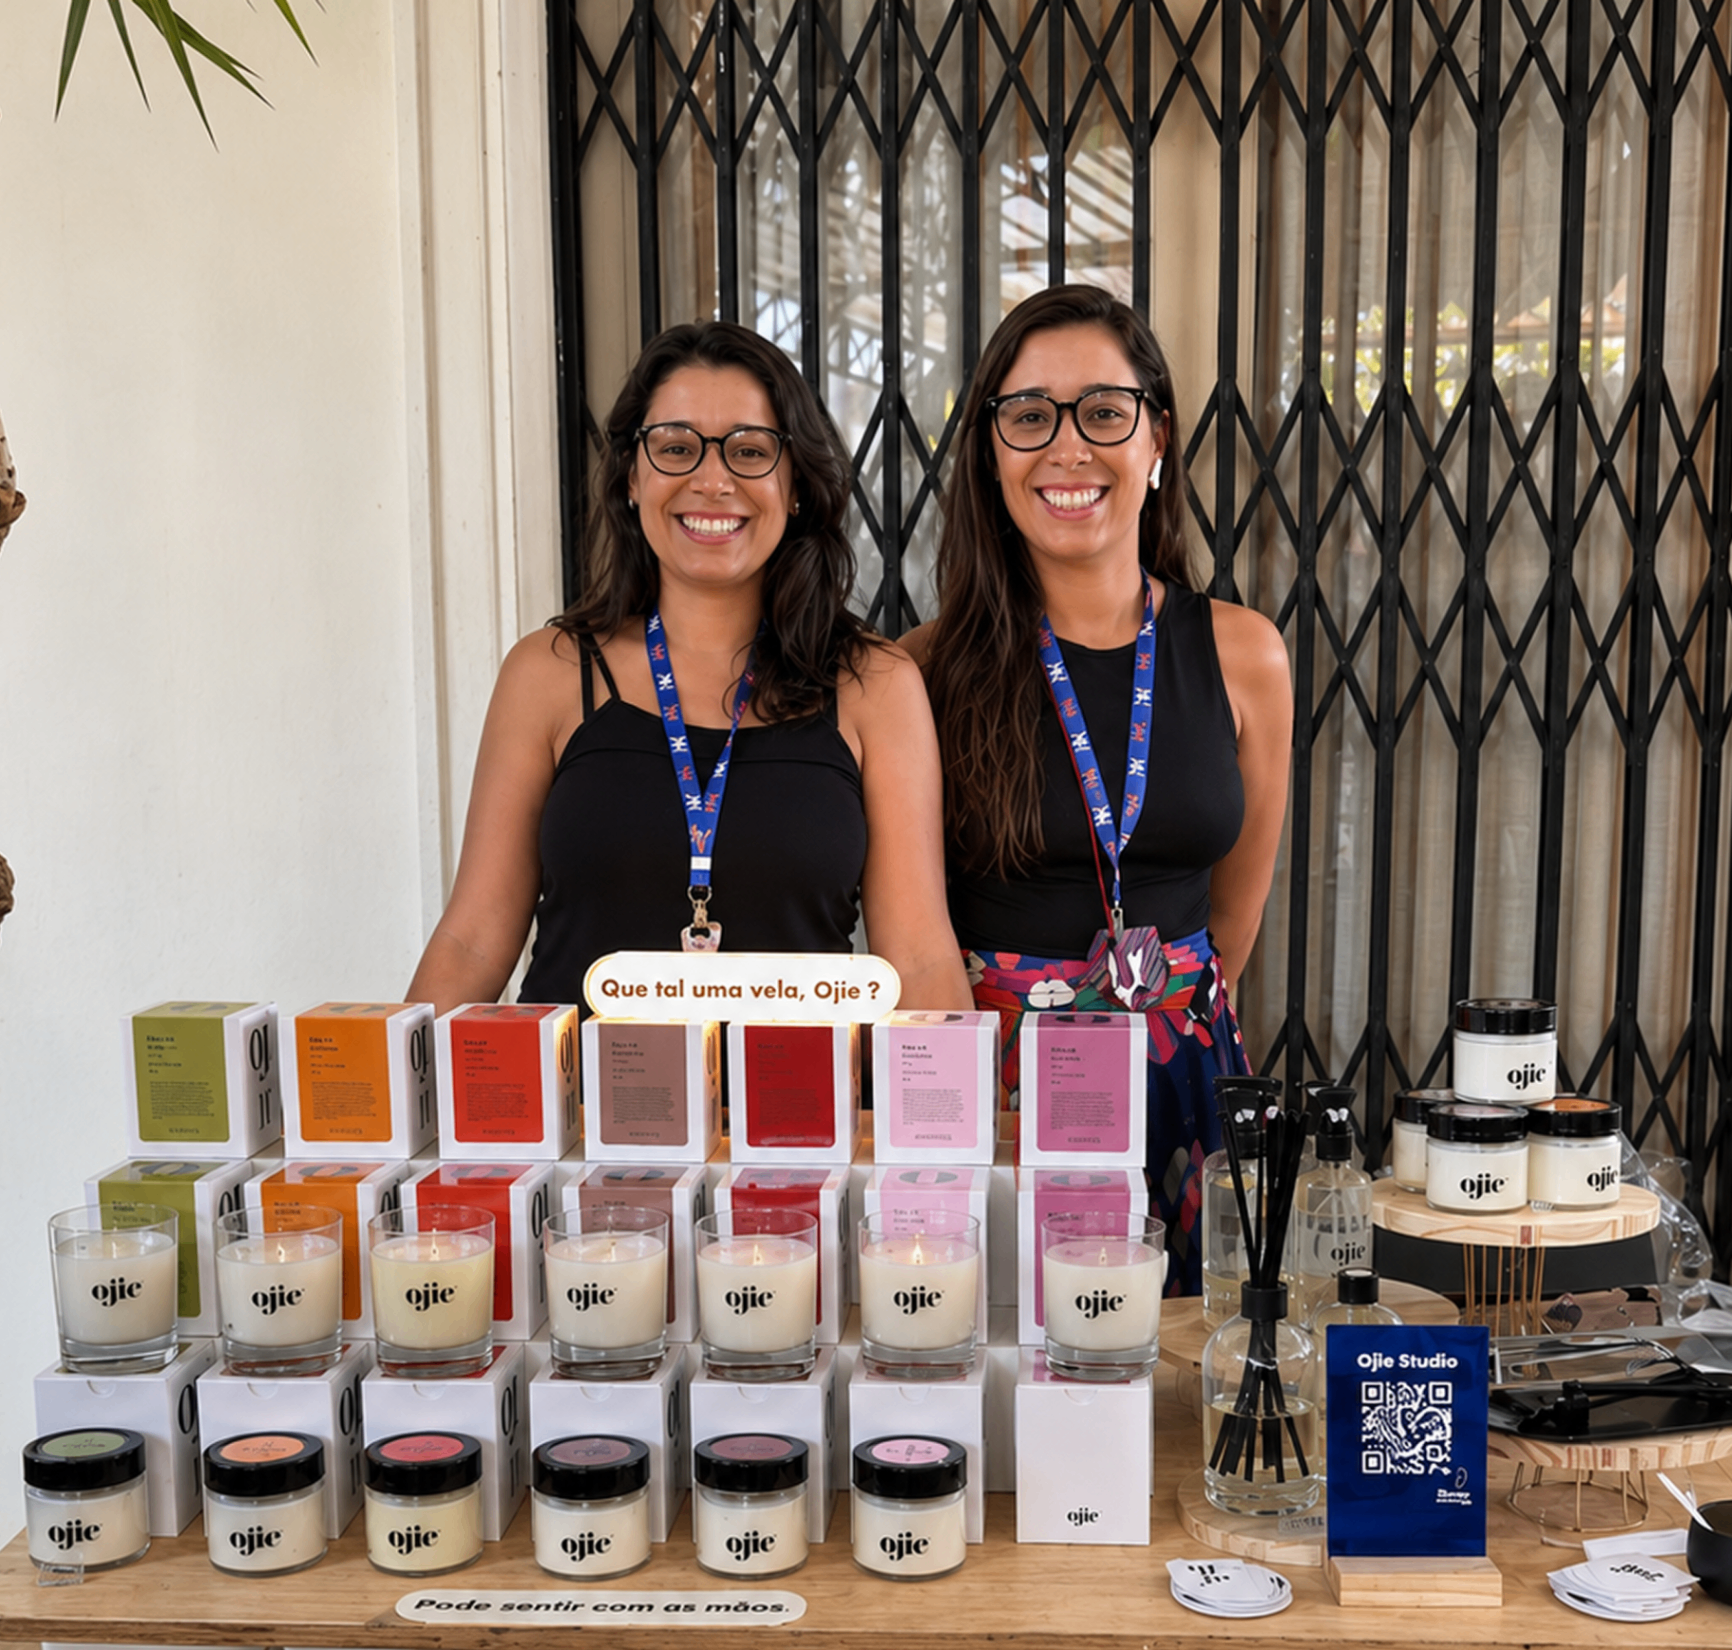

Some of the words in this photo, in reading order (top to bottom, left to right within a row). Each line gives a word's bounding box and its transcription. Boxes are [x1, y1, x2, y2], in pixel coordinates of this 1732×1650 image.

[600, 978, 648, 999] Que
[655, 978, 684, 998] tal
[692, 985, 743, 999] uma
[750, 978, 805, 1002] vela,
[813, 980, 861, 1005] Ojie
[867, 980, 881, 1000] ?
[1460, 1173, 1505, 1199] ojie
[91, 1277, 142, 1307] ojie
[251, 1284, 302, 1315] ojie
[405, 1282, 455, 1312] ojie
[567, 1283, 614, 1311] ojie
[725, 1285, 773, 1315] ojie
[894, 1285, 941, 1315] ojie
[1075, 1290, 1123, 1319] ojie
[1357, 1352, 1395, 1373] Ojie
[1398, 1352, 1459, 1369] Studio
[1066, 1507, 1099, 1527] ojie
[48, 1519, 100, 1550] ojie
[229, 1525, 281, 1556] ojie
[388, 1525, 438, 1555] ojie
[561, 1531, 612, 1562] ojie
[726, 1530, 776, 1561] ojie
[880, 1531, 929, 1561] ojie
[414, 1599, 492, 1610] Pode
[500, 1600, 585, 1612] sentir
[592, 1603, 655, 1613] com
[663, 1603, 696, 1613] as
